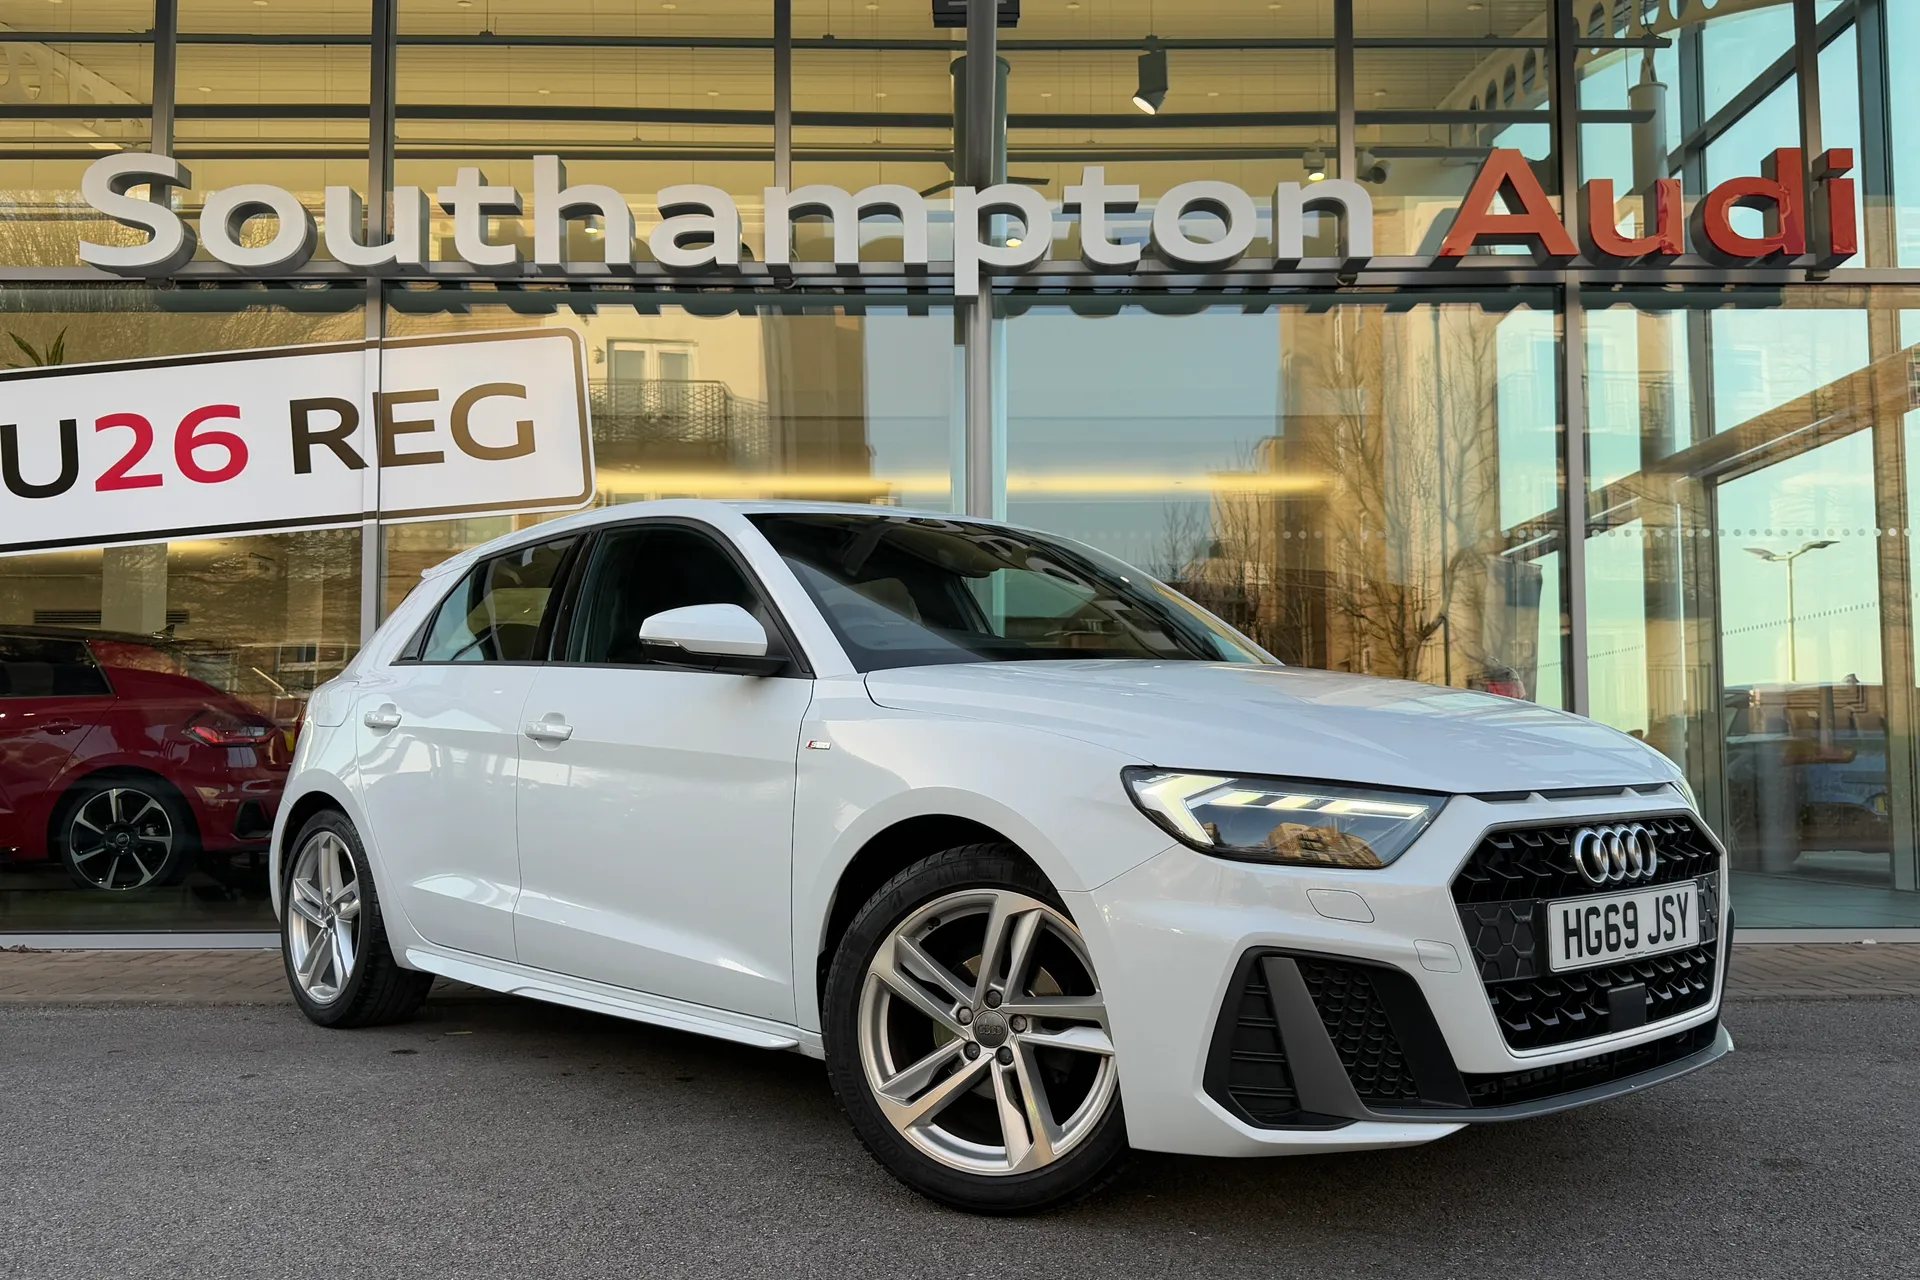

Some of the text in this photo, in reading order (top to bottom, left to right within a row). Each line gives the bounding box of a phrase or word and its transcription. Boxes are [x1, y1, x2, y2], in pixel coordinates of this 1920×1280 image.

[79, 148, 1857, 297] Southampton Audi
[0, 382, 536, 498] U26 REG
[1562, 891, 1689, 960] HG69 JSY
